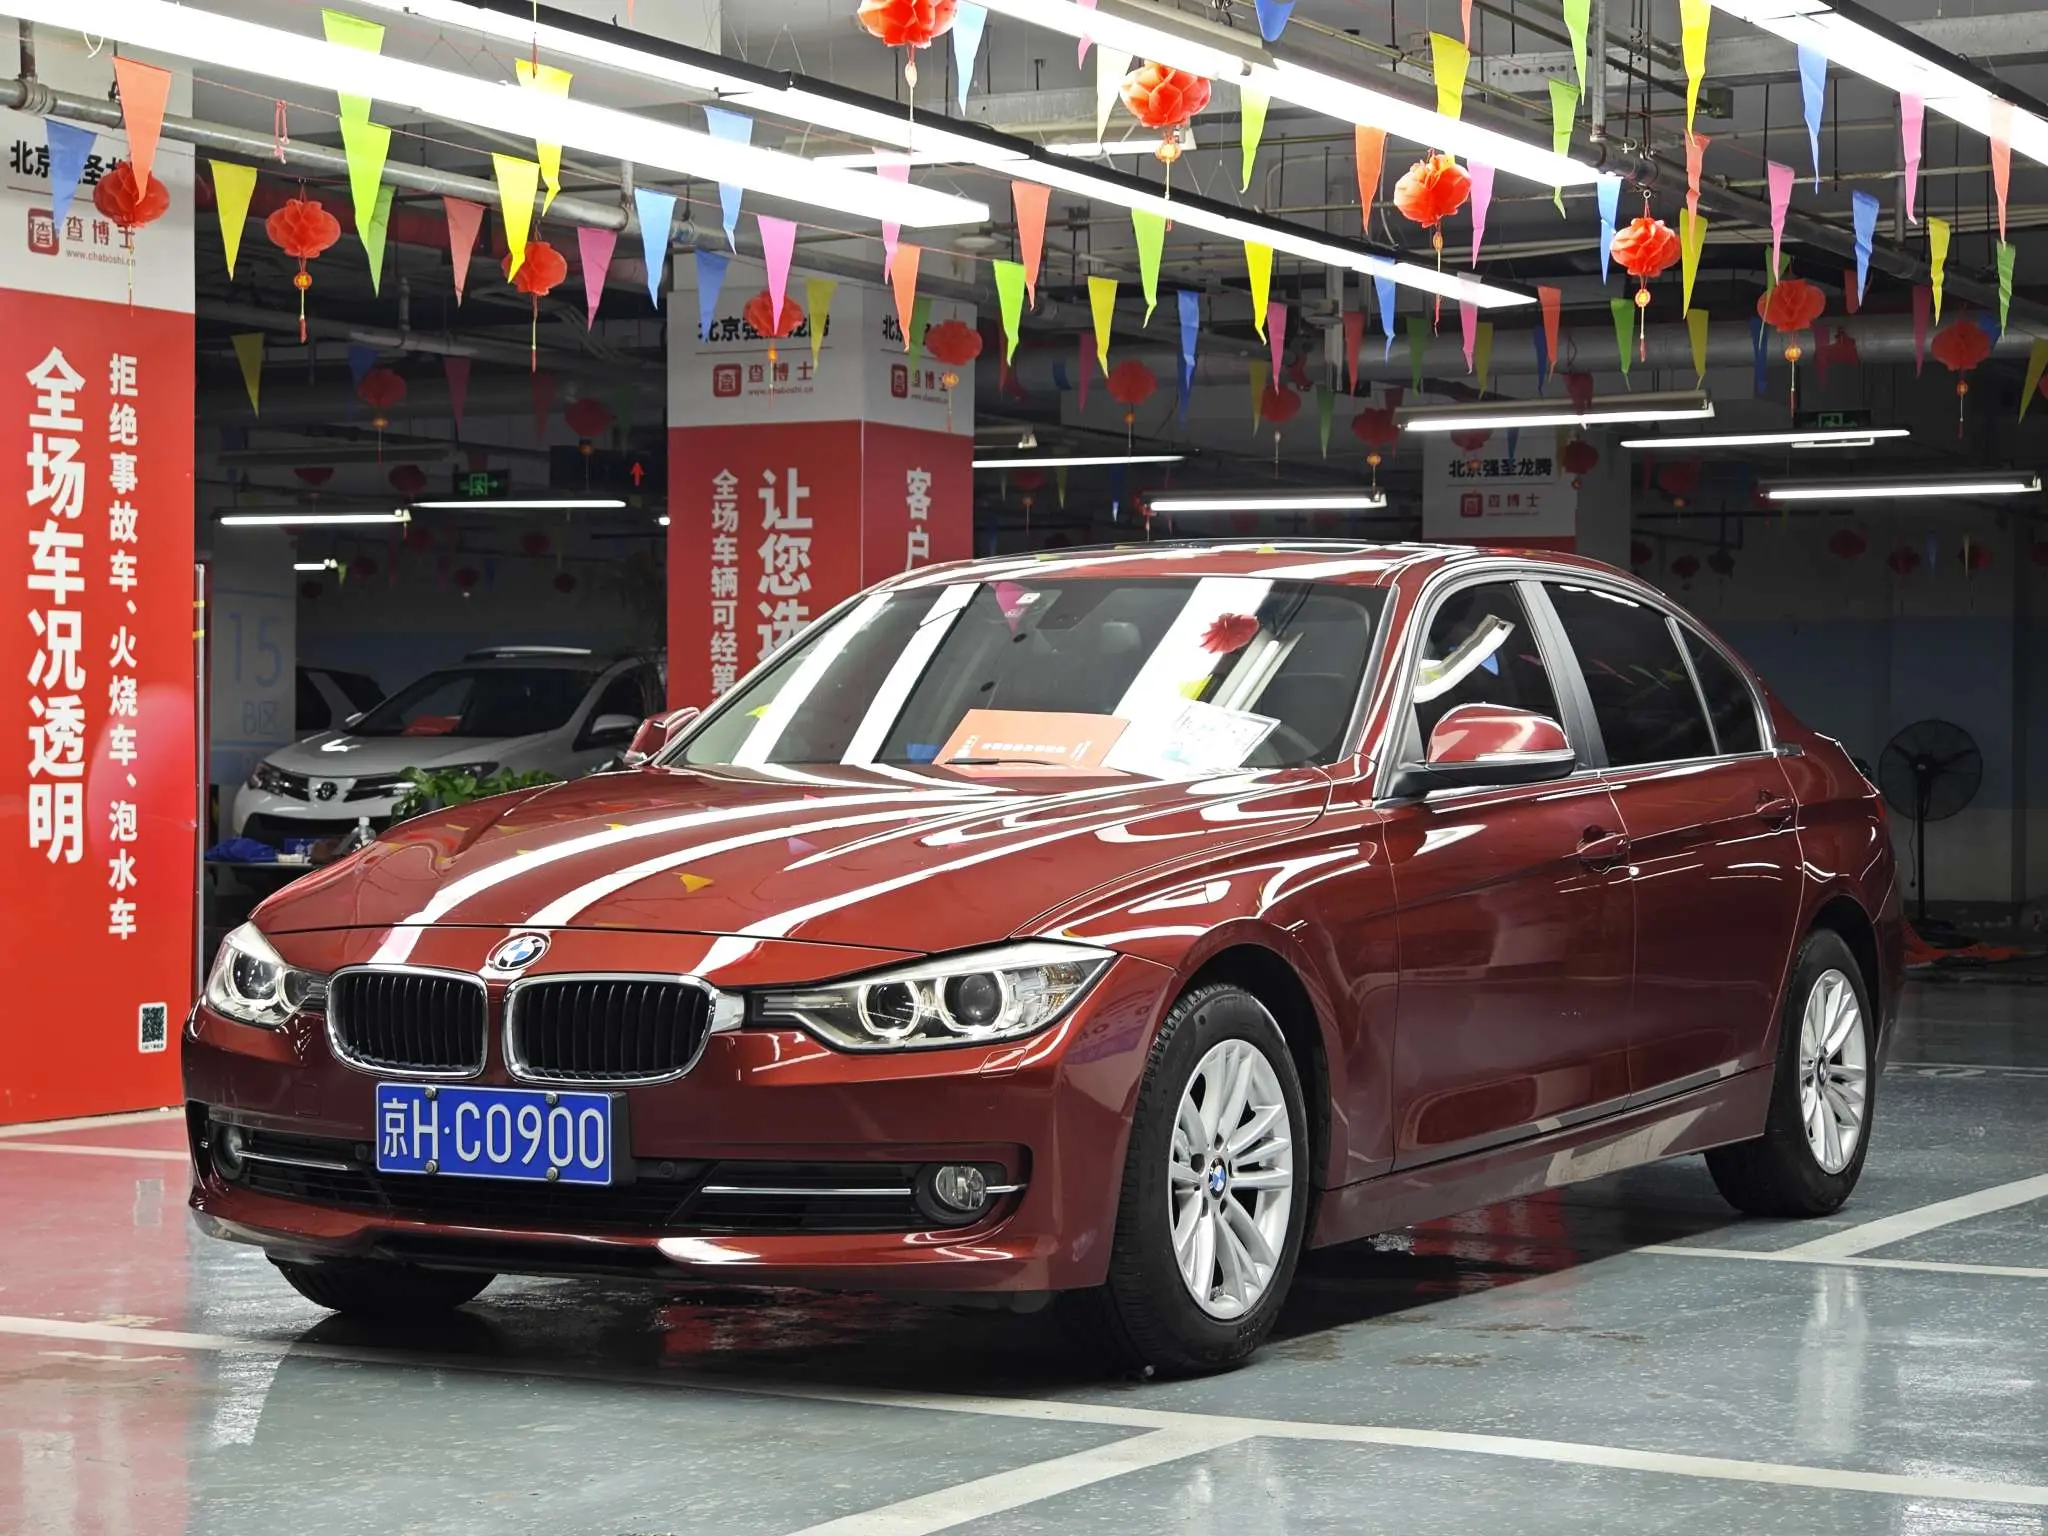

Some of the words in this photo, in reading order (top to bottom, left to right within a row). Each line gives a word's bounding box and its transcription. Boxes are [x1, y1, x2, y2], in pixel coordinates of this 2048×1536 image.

[66, 215, 136, 249] 查博士
[748, 361, 814, 383] 查博士
[904, 467, 932, 571] 客户
[26, 346, 87, 864] 全场车况透明
[108, 352, 139, 941] 拒绝事故车、火烧车、泡水车
[228, 612, 283, 687] 15
